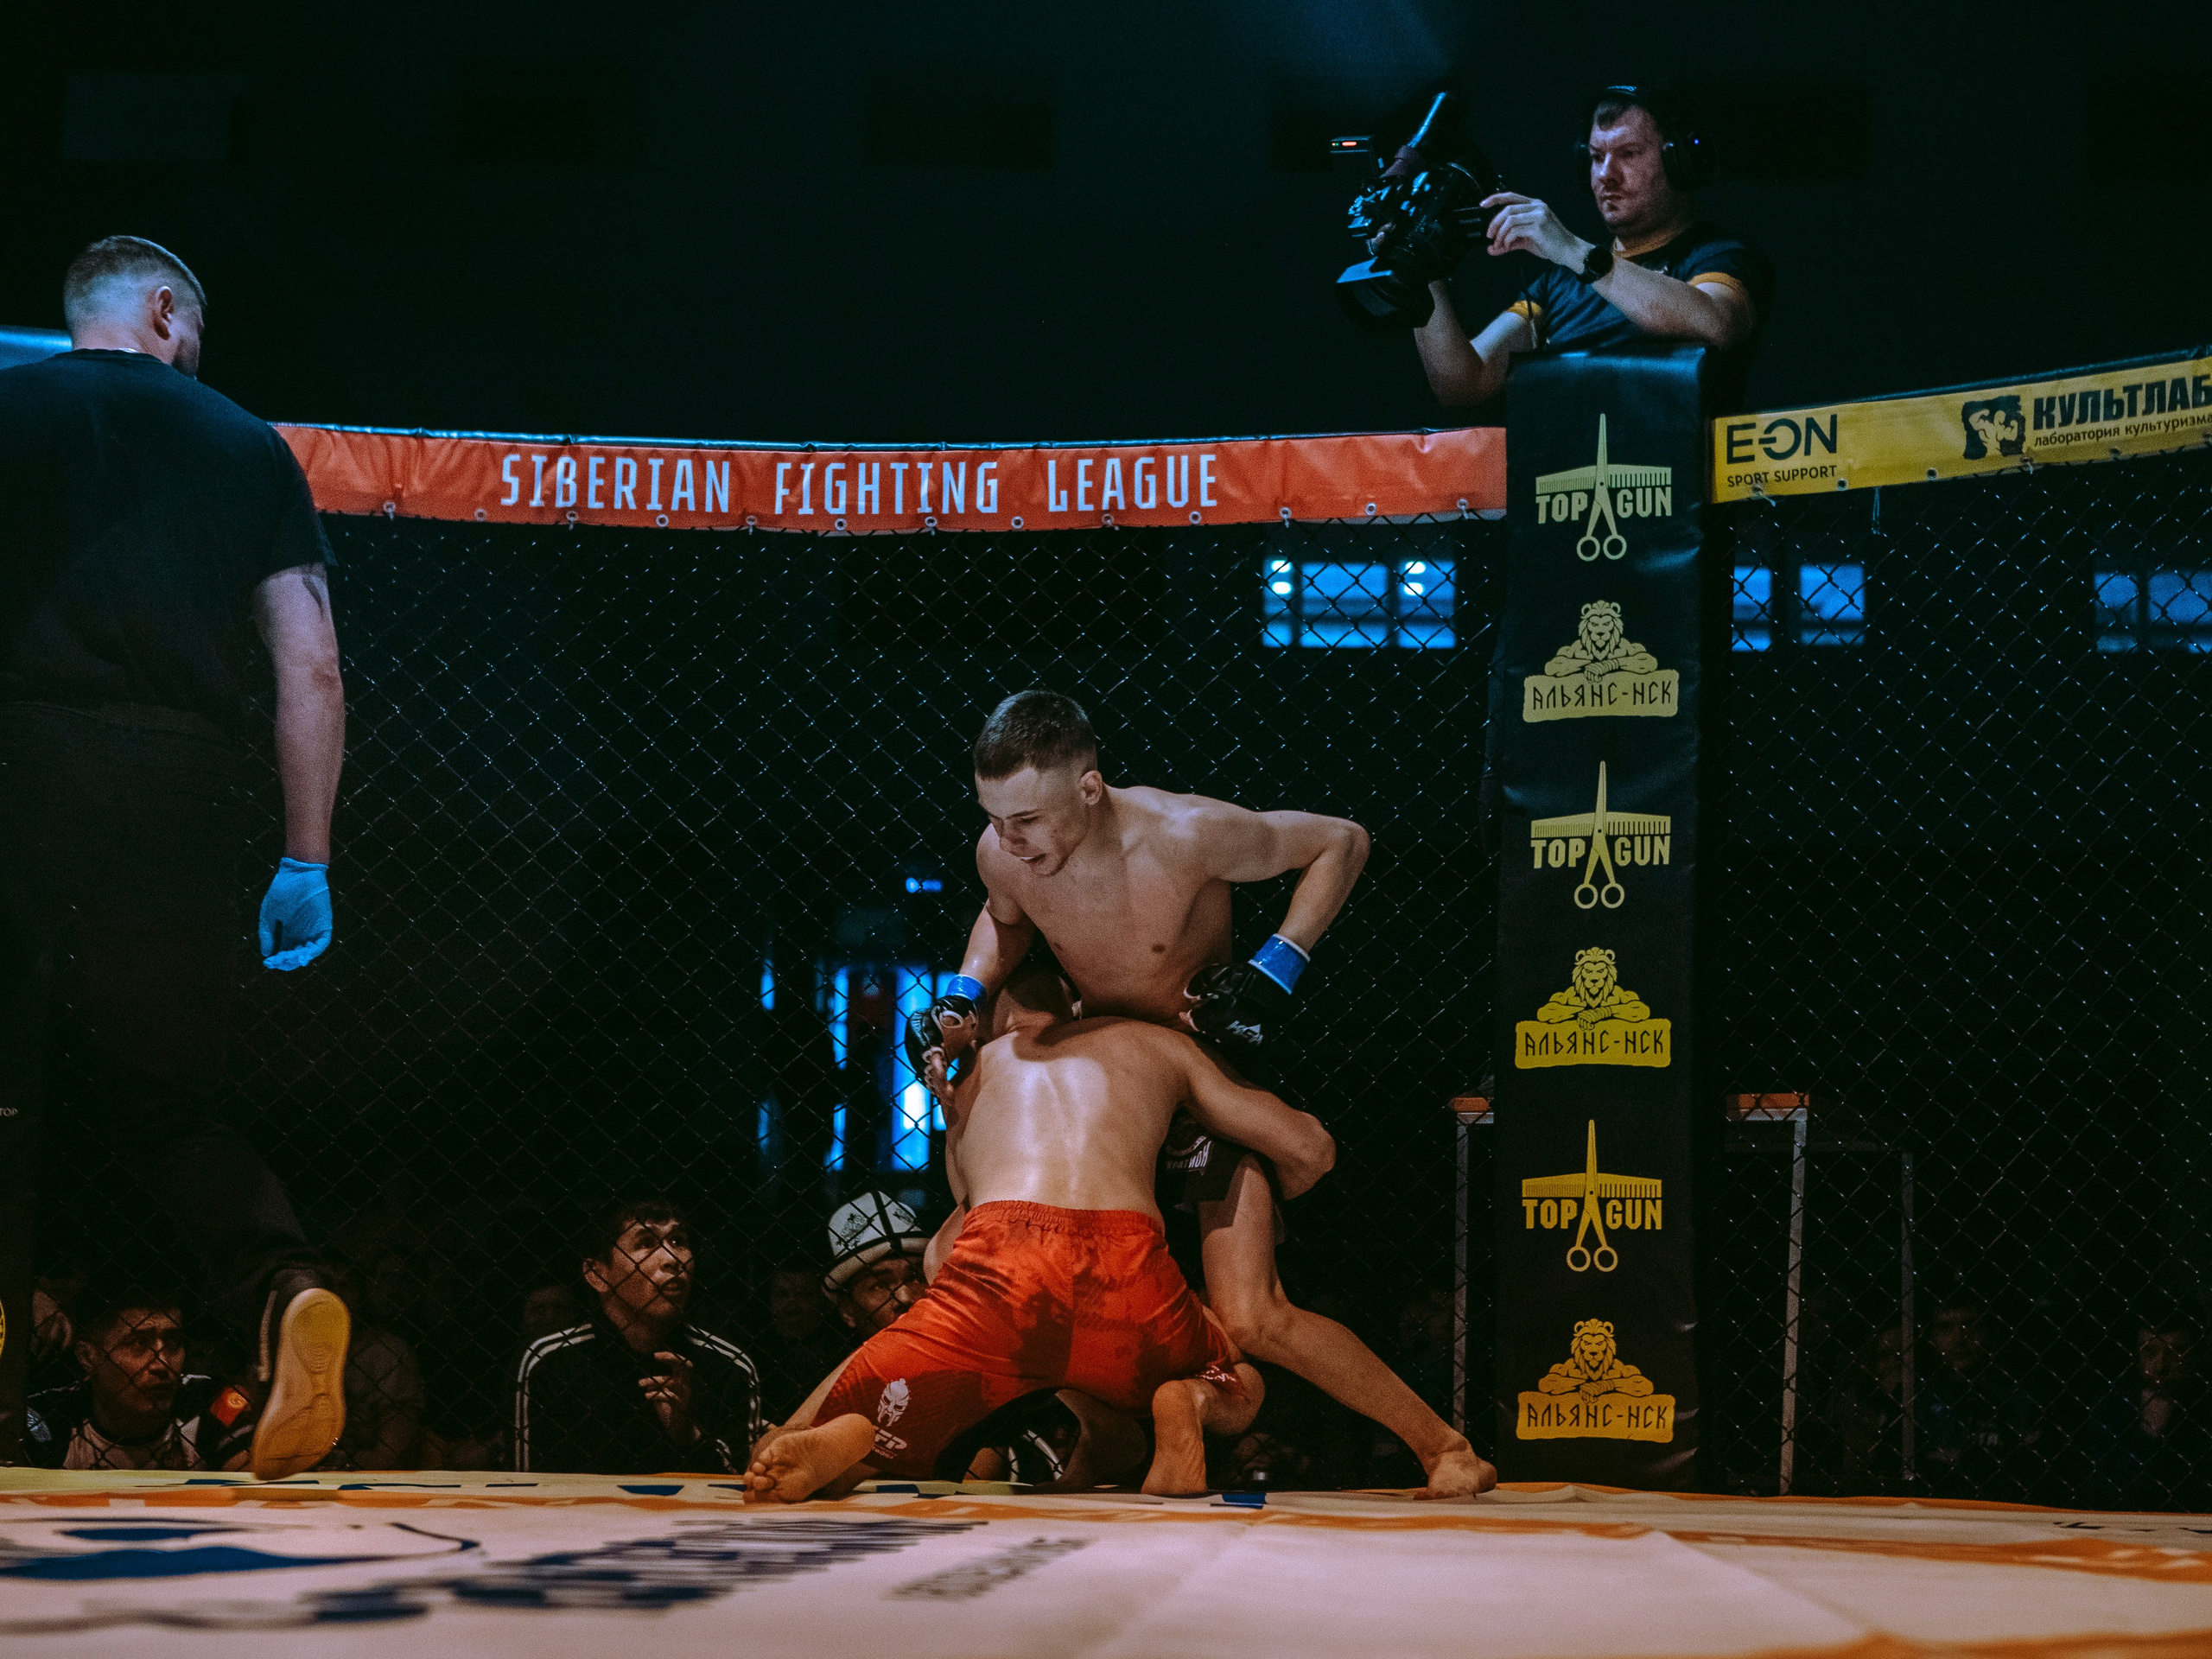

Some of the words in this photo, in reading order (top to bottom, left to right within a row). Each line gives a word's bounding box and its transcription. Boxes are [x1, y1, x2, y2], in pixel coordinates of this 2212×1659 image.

[2033, 374, 2212, 430] КУЛЬТЛАБ
[2034, 427, 2120, 447] лаборатория
[2125, 413, 2212, 437] культуризма
[500, 454, 729, 513] SIBERIAN
[774, 461, 998, 515] FIGHTING
[1047, 454, 1217, 512] LEAGUE
[1727, 472, 1770, 488] SPORT
[1774, 465, 1837, 483] SUPPORT
[1535, 492, 1588, 524] TOP
[1617, 486, 1672, 518] GUN
[1530, 837, 1586, 869] TOP
[1614, 835, 1671, 867] GUN
[1522, 1198, 1578, 1230] TOP
[1606, 1198, 1662, 1230] GUN
